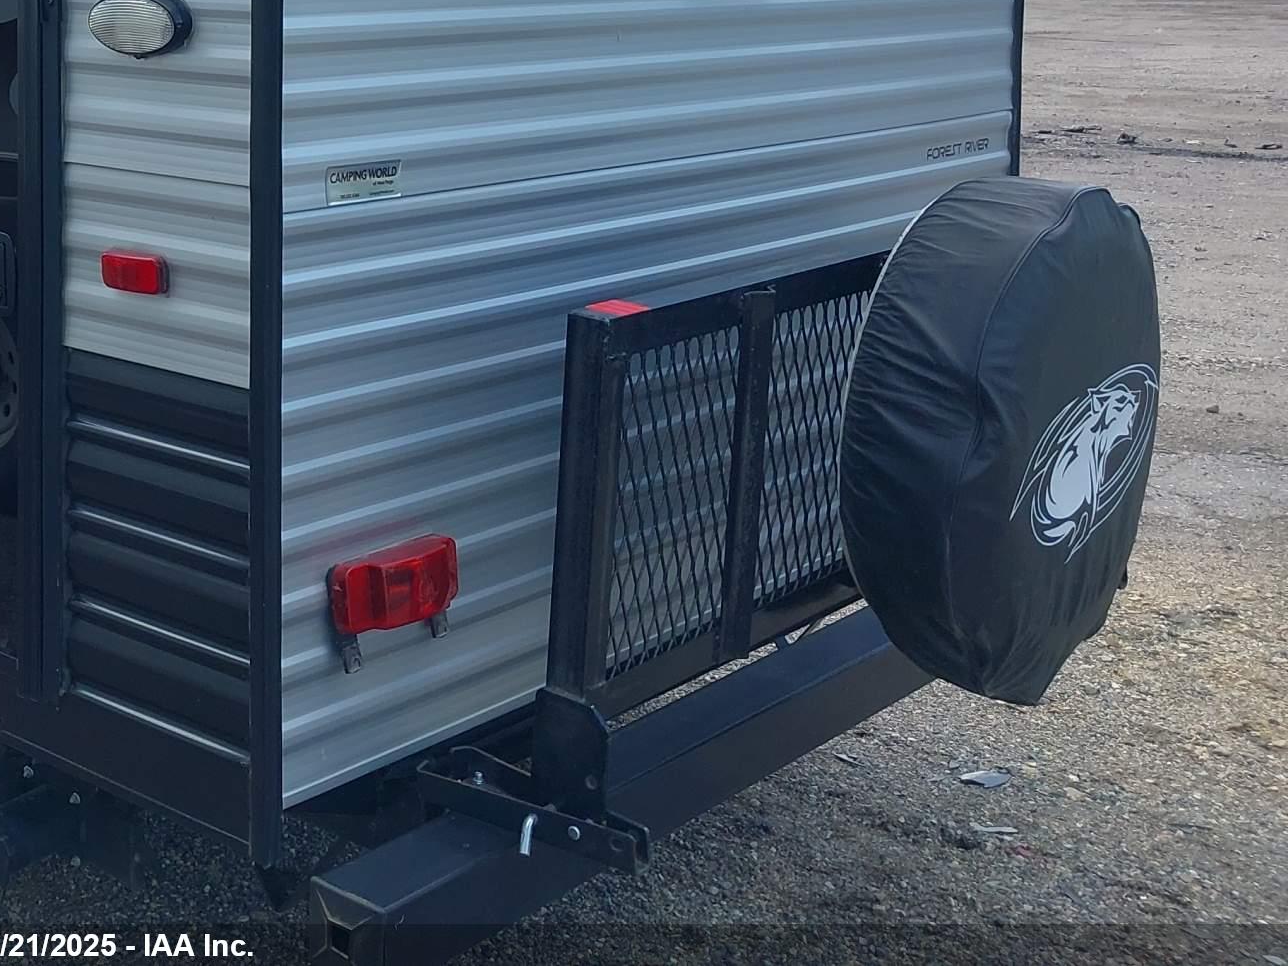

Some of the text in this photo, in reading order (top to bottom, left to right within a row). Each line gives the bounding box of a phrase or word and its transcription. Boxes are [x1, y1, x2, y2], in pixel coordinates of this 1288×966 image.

[927, 138, 989, 161] FOREST RIVER
[329, 169, 367, 184] CAMPING
[368, 166, 397, 179] WORLD
